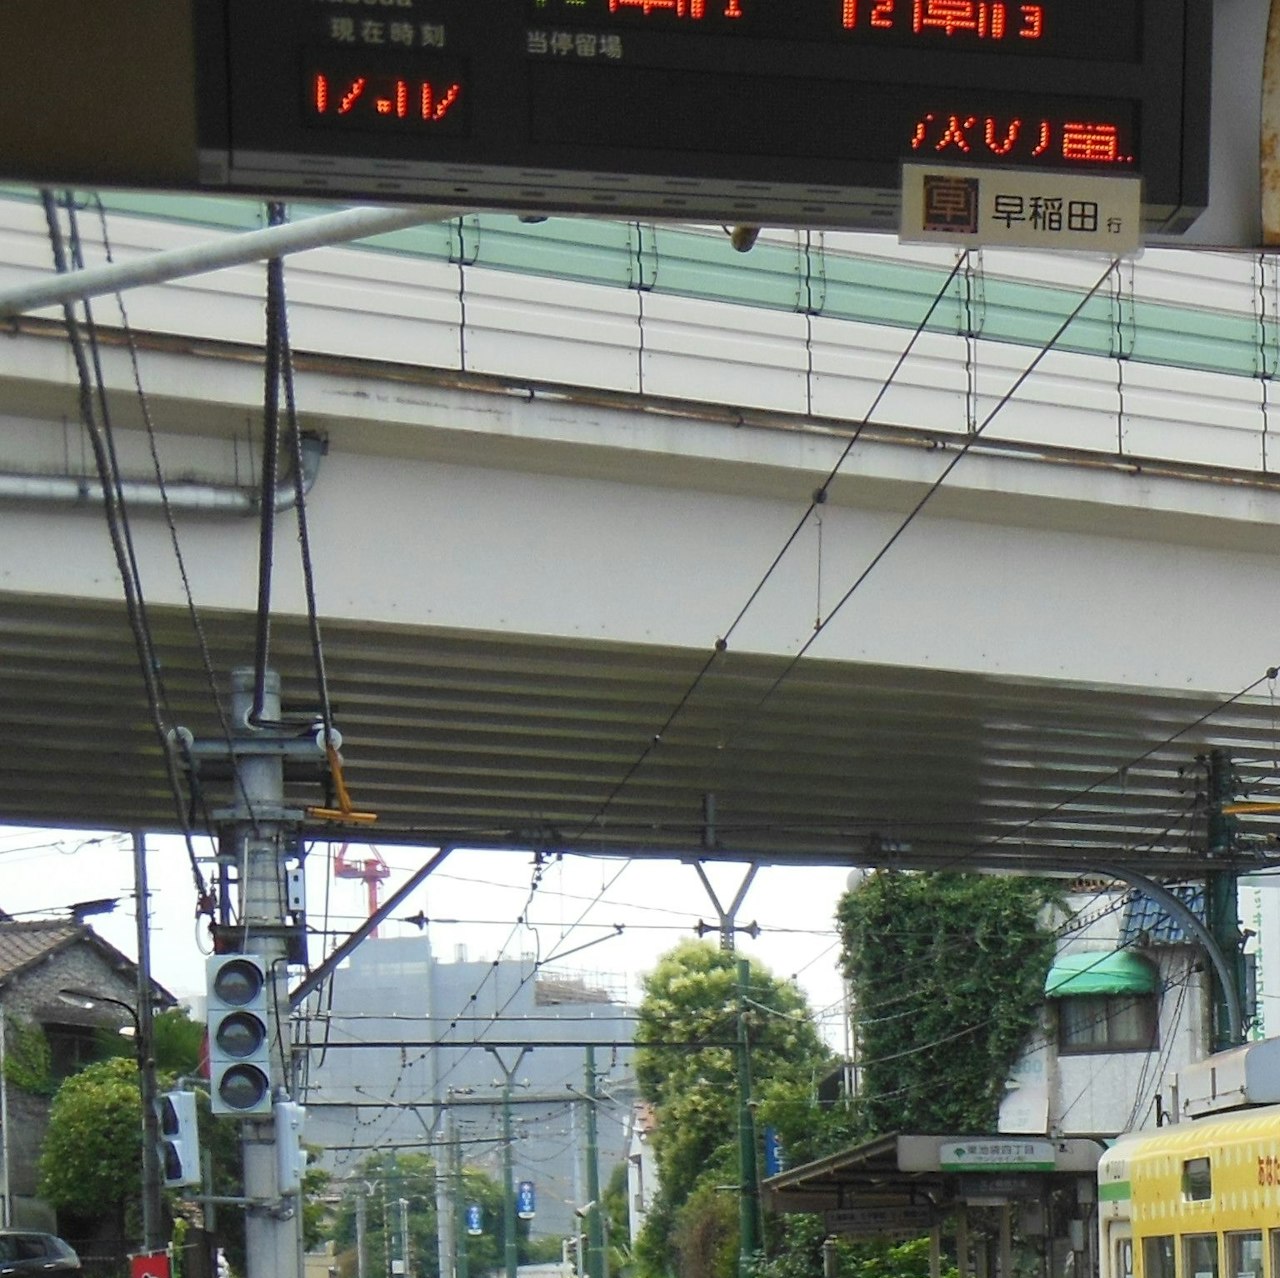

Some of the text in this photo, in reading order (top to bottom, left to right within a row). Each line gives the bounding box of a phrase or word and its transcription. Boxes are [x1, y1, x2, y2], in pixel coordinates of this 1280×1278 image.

[330, 17, 447, 48] 現在時刻
[526, 30, 624, 59] 当停留場
[991, 194, 1122, 235] 早稲田 行
